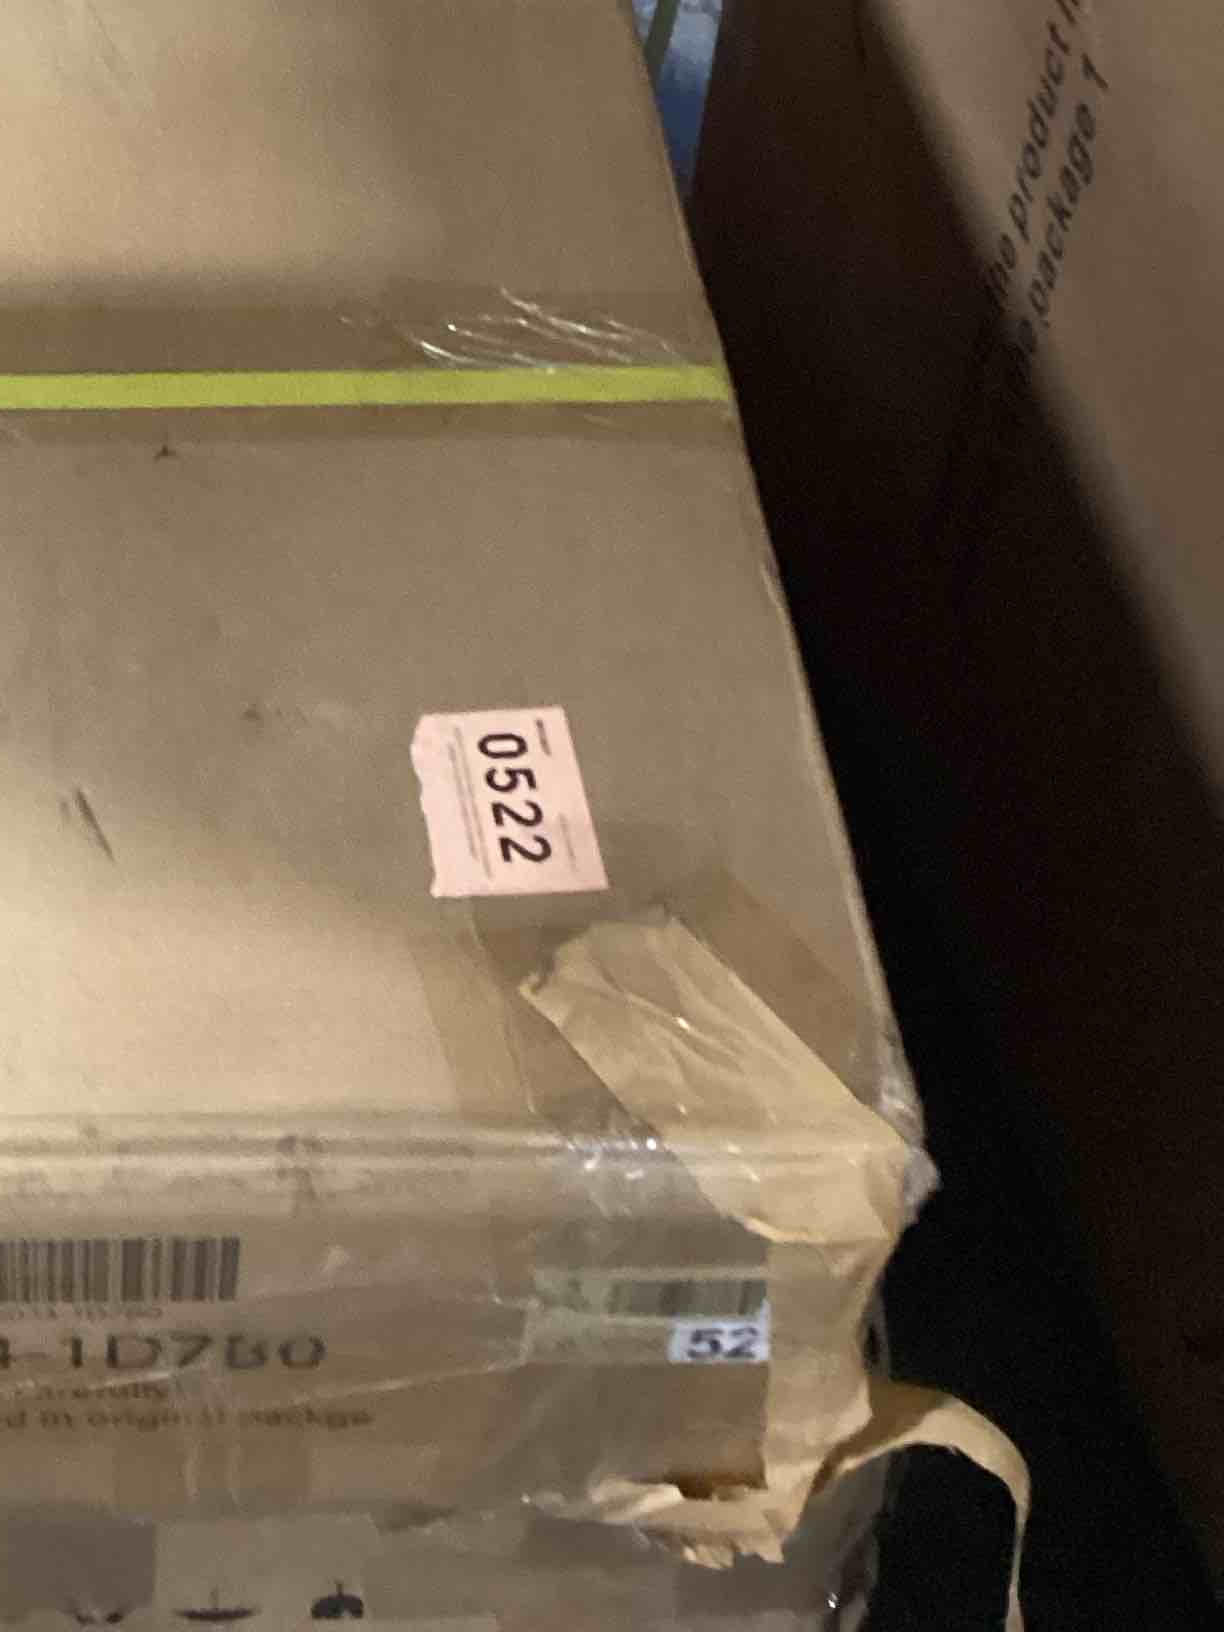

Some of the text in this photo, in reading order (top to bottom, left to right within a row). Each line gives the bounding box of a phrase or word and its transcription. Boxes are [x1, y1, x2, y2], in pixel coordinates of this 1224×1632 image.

[1006, 19, 1071, 242] product
[1027, 51, 1109, 329] package 1
[477, 732, 552, 864] 0522
[687, 1326, 760, 1360] 52
